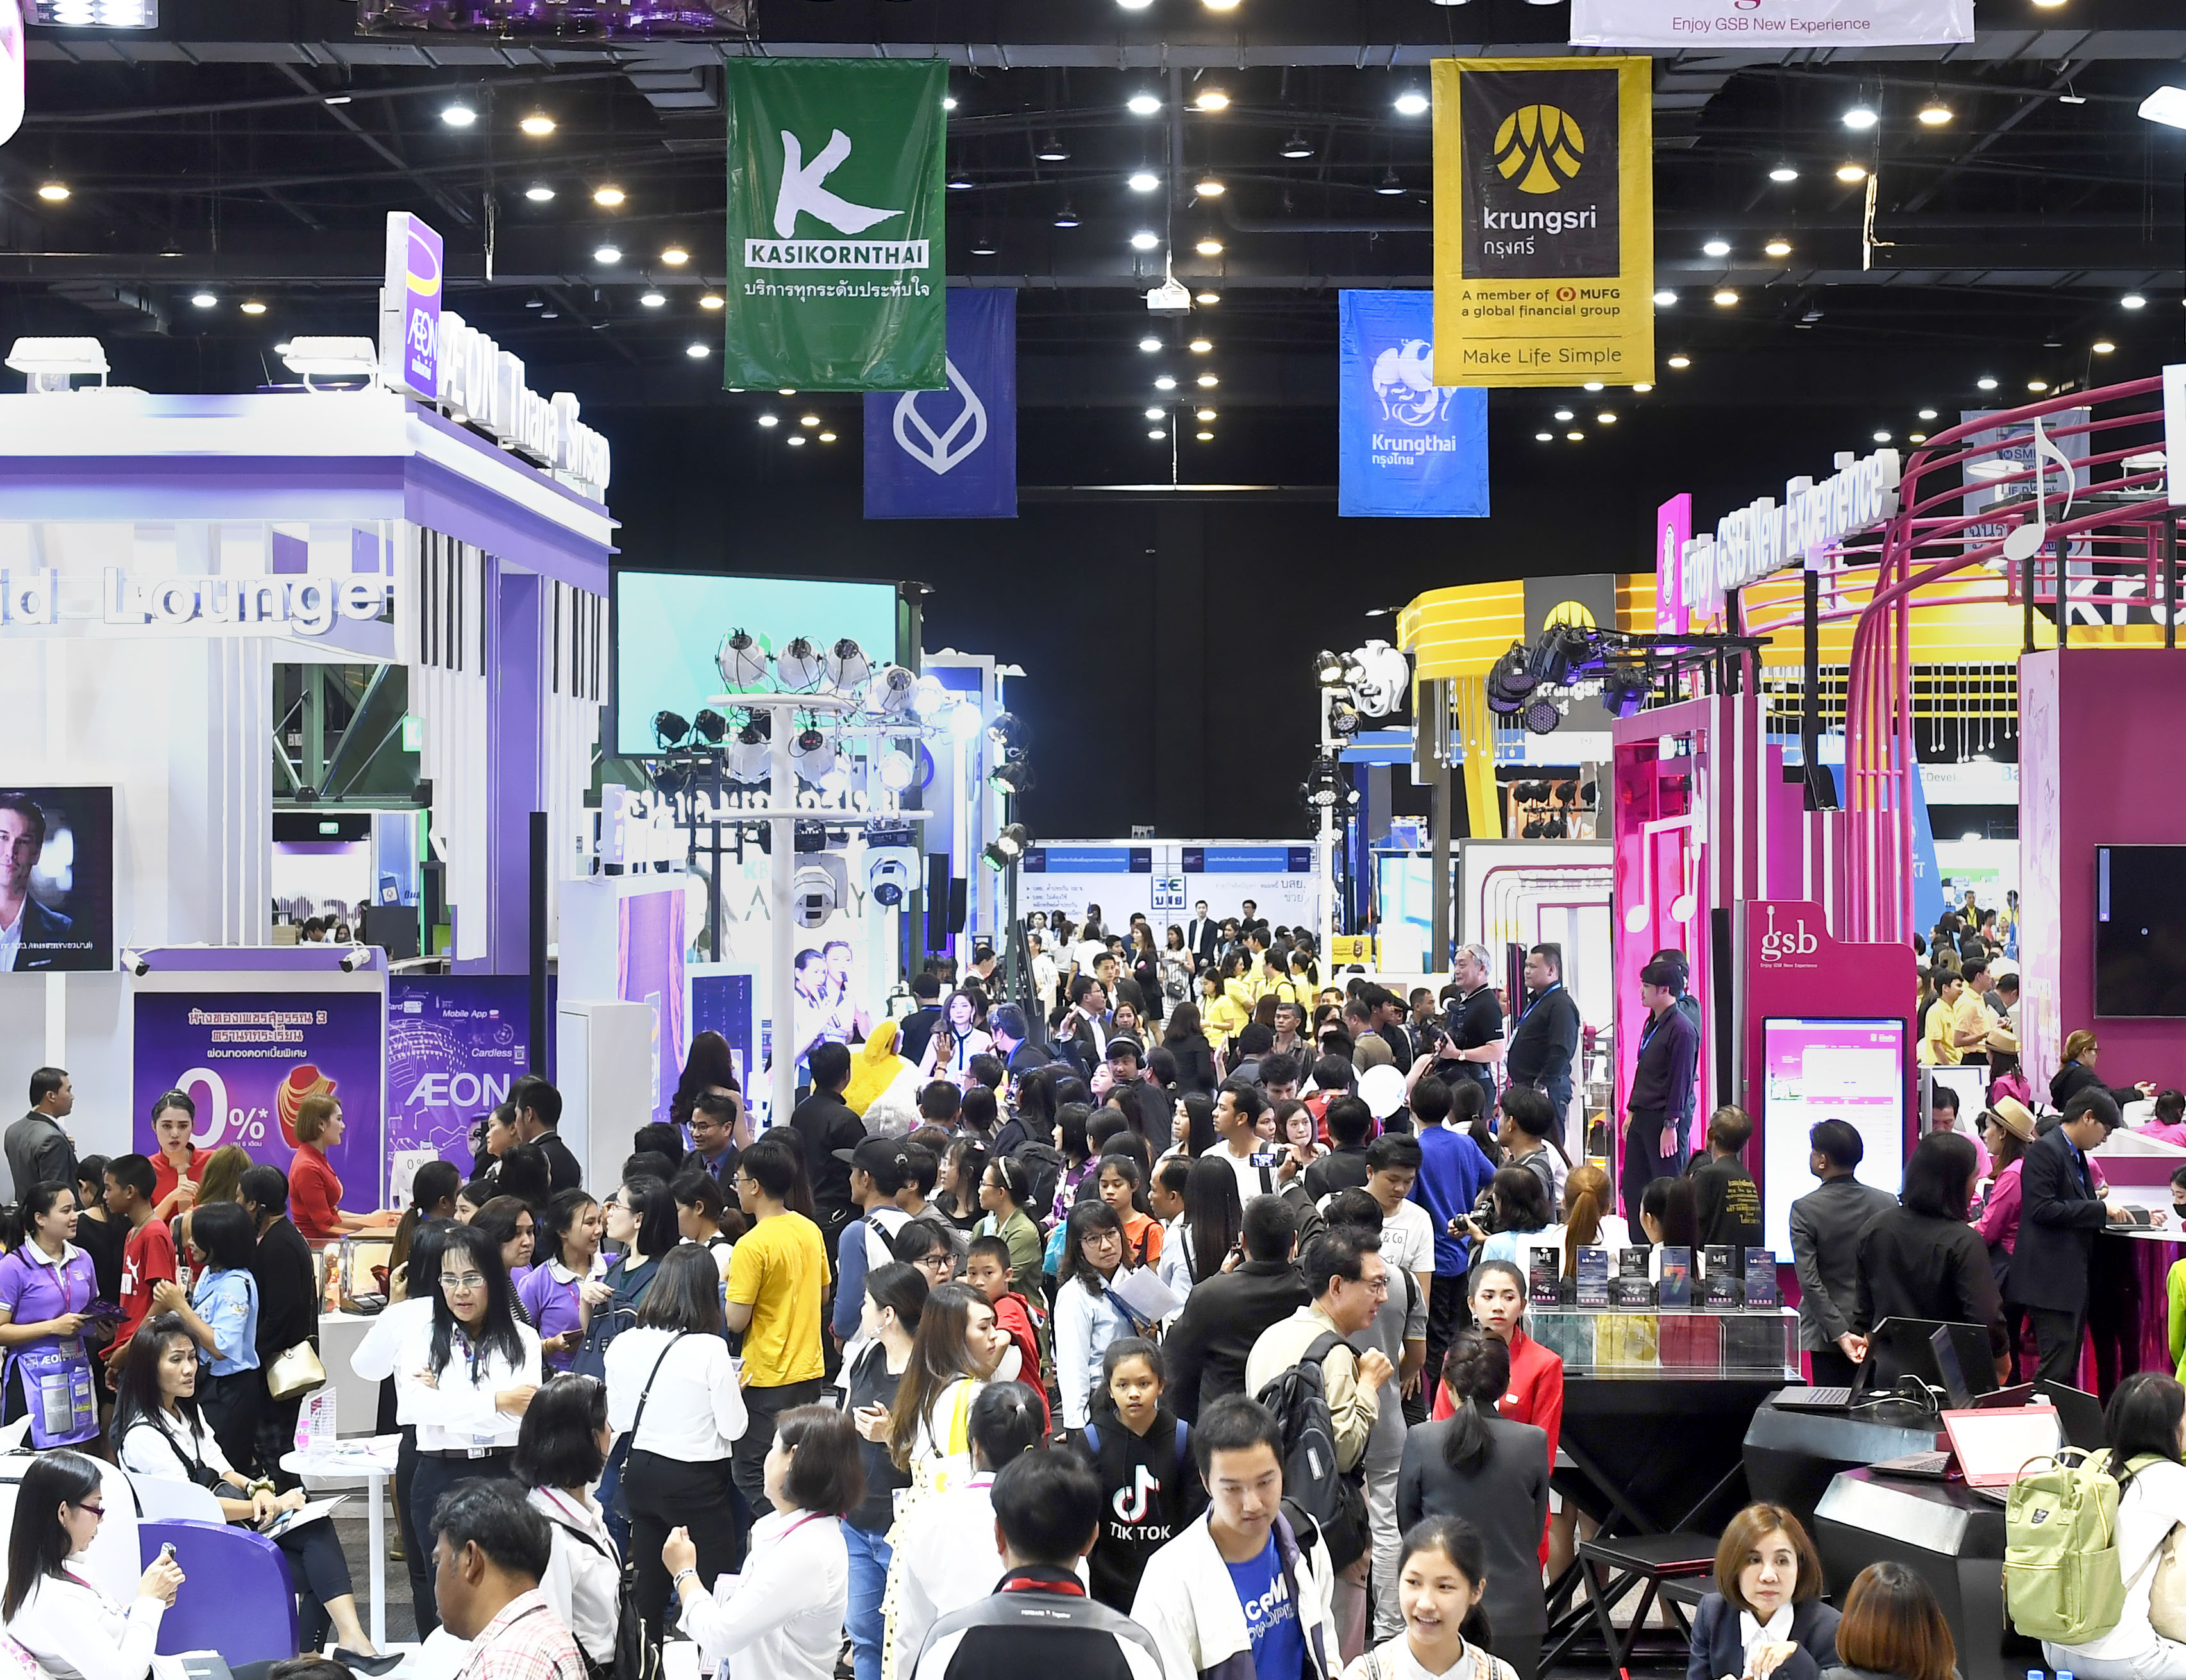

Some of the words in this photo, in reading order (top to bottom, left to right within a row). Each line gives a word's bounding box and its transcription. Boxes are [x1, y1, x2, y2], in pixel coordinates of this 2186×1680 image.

[1672, 17, 1711, 33] Enjoy
[1715, 17, 1749, 30] GSB
[1754, 18, 1786, 30] New
[1790, 18, 1871, 33] Experience
[1484, 205, 1596, 234] krungsri
[752, 244, 922, 264] KASIKORNTHAI
[1484, 235, 1534, 259] กรุงศรี
[744, 276, 930, 303] บริการทุกระดับประทับใจ
[1462, 290, 1471, 300] A
[1477, 290, 1531, 300] member
[1536, 289, 1549, 302] of
[1581, 289, 1620, 299] MUFG
[1461, 307, 1469, 316] a
[1474, 305, 1515, 318] global
[1519, 305, 1576, 318] financial
[1580, 306, 1620, 317] group
[1463, 348, 1511, 364] Make
[1518, 348, 1551, 366] Life
[1559, 347, 1622, 365] Simple
[498, 351, 559, 463] Thana
[1372, 433, 1456, 455] Krungthai
[1372, 452, 1414, 468] กรุงไทย
[1681, 533, 1723, 621] Enjoy
[1717, 507, 1750, 591] GSB
[1749, 497, 1787, 575] New
[1786, 449, 1900, 571] Experience
[104, 567, 385, 635] Lounge
[1761, 905, 1818, 962] gsb
[316, 1011, 327, 1024] 3
[442, 1009, 469, 1018] Mobile
[471, 1010, 487, 1019] App
[471, 1048, 512, 1057] Cardless
[1384, 1232, 1390, 1243] &
[1393, 1233, 1404, 1244] Co.
[1110, 1522, 1133, 1540] TIK
[1137, 1525, 1171, 1540] TOK
